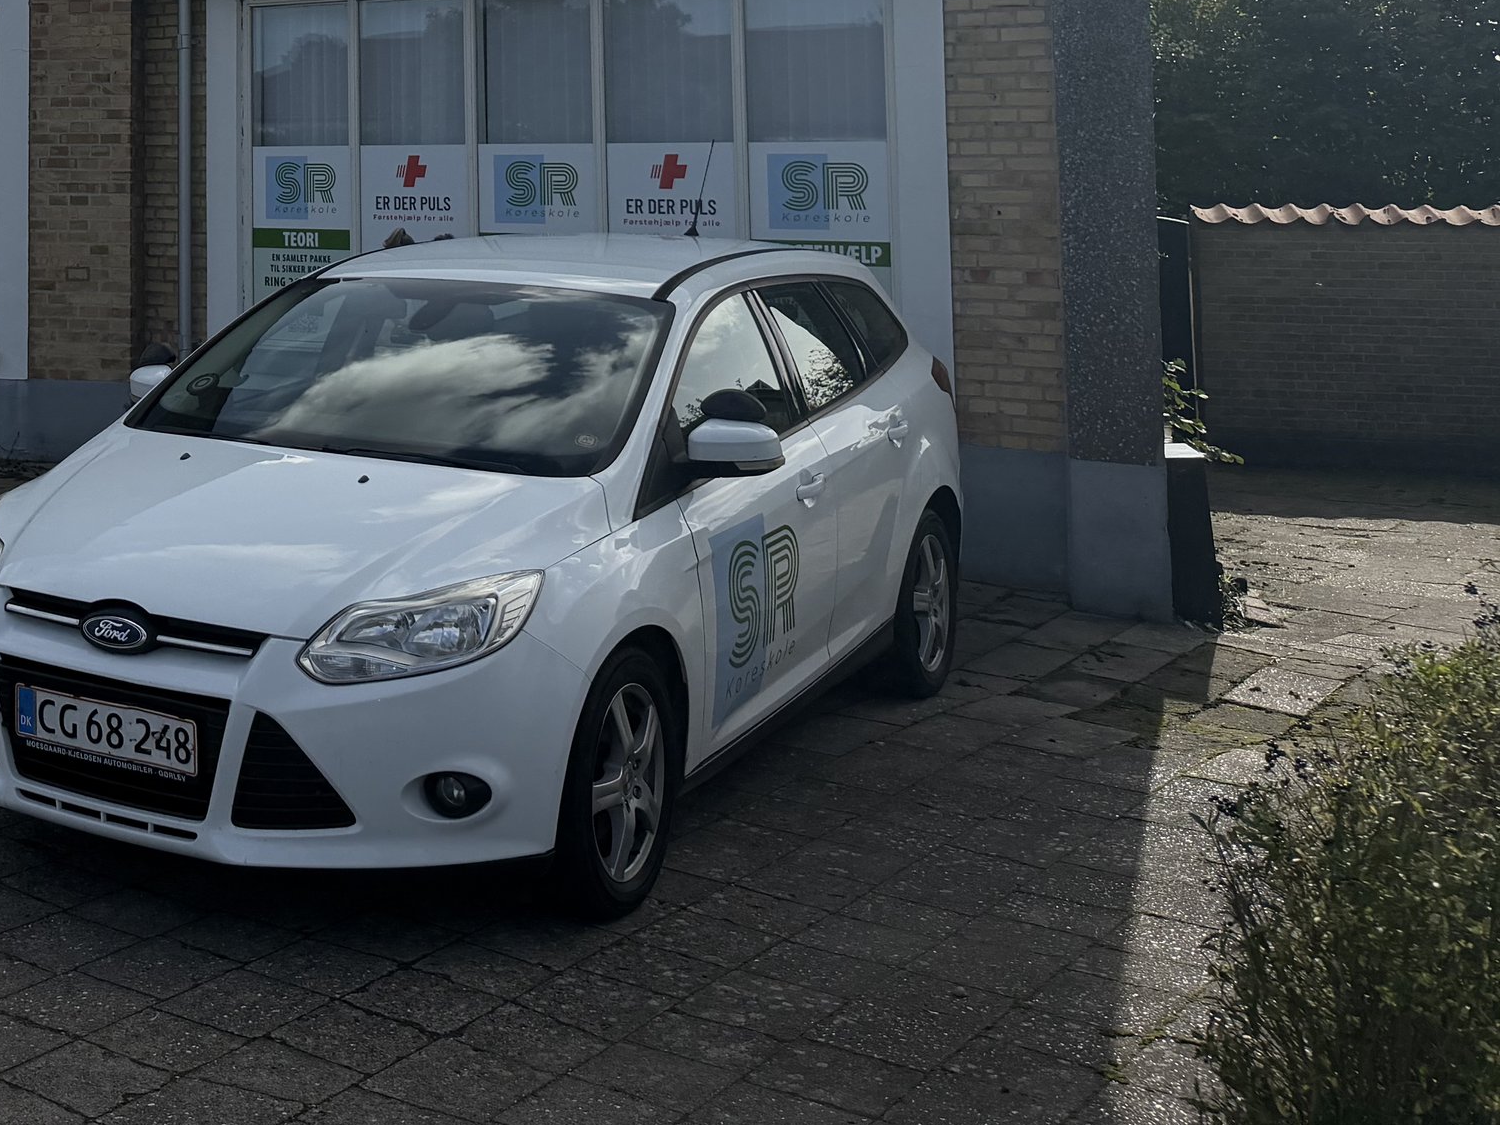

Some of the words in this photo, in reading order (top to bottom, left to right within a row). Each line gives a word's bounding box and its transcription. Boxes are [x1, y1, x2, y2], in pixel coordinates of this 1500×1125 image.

[275, 162, 336, 204] SR
[505, 161, 578, 206] SR
[782, 161, 868, 211] SR
[274, 205, 337, 214] Køreskole
[375, 196, 390, 210] ER
[394, 197, 416, 210] DER
[421, 197, 451, 211] PULS
[626, 198, 643, 214] ER
[648, 199, 675, 215] DER
[680, 200, 717, 215] PULS
[373, 214, 421, 222] Førstehjælp
[505, 209, 580, 218] Køreskole
[781, 213, 870, 223] Køreskole
[624, 219, 680, 227] Førstehjælp
[283, 231, 318, 247] TEORI
[272, 254, 280, 262] EN
[282, 254, 308, 262] SAMLET
[309, 255, 331, 263] PAKKE
[270, 264, 280, 272] TIL
[282, 265, 306, 273] SIKKER
[265, 277, 285, 287] RING
[729, 525, 799, 668] SR
[94, 620, 131, 641] Ford
[21, 715, 32, 727] DK
[39, 699, 78, 739] CG
[86, 708, 123, 749] 68
[134, 718, 191, 764] 248
[103, 757, 153, 774] AUTOMOBILER
